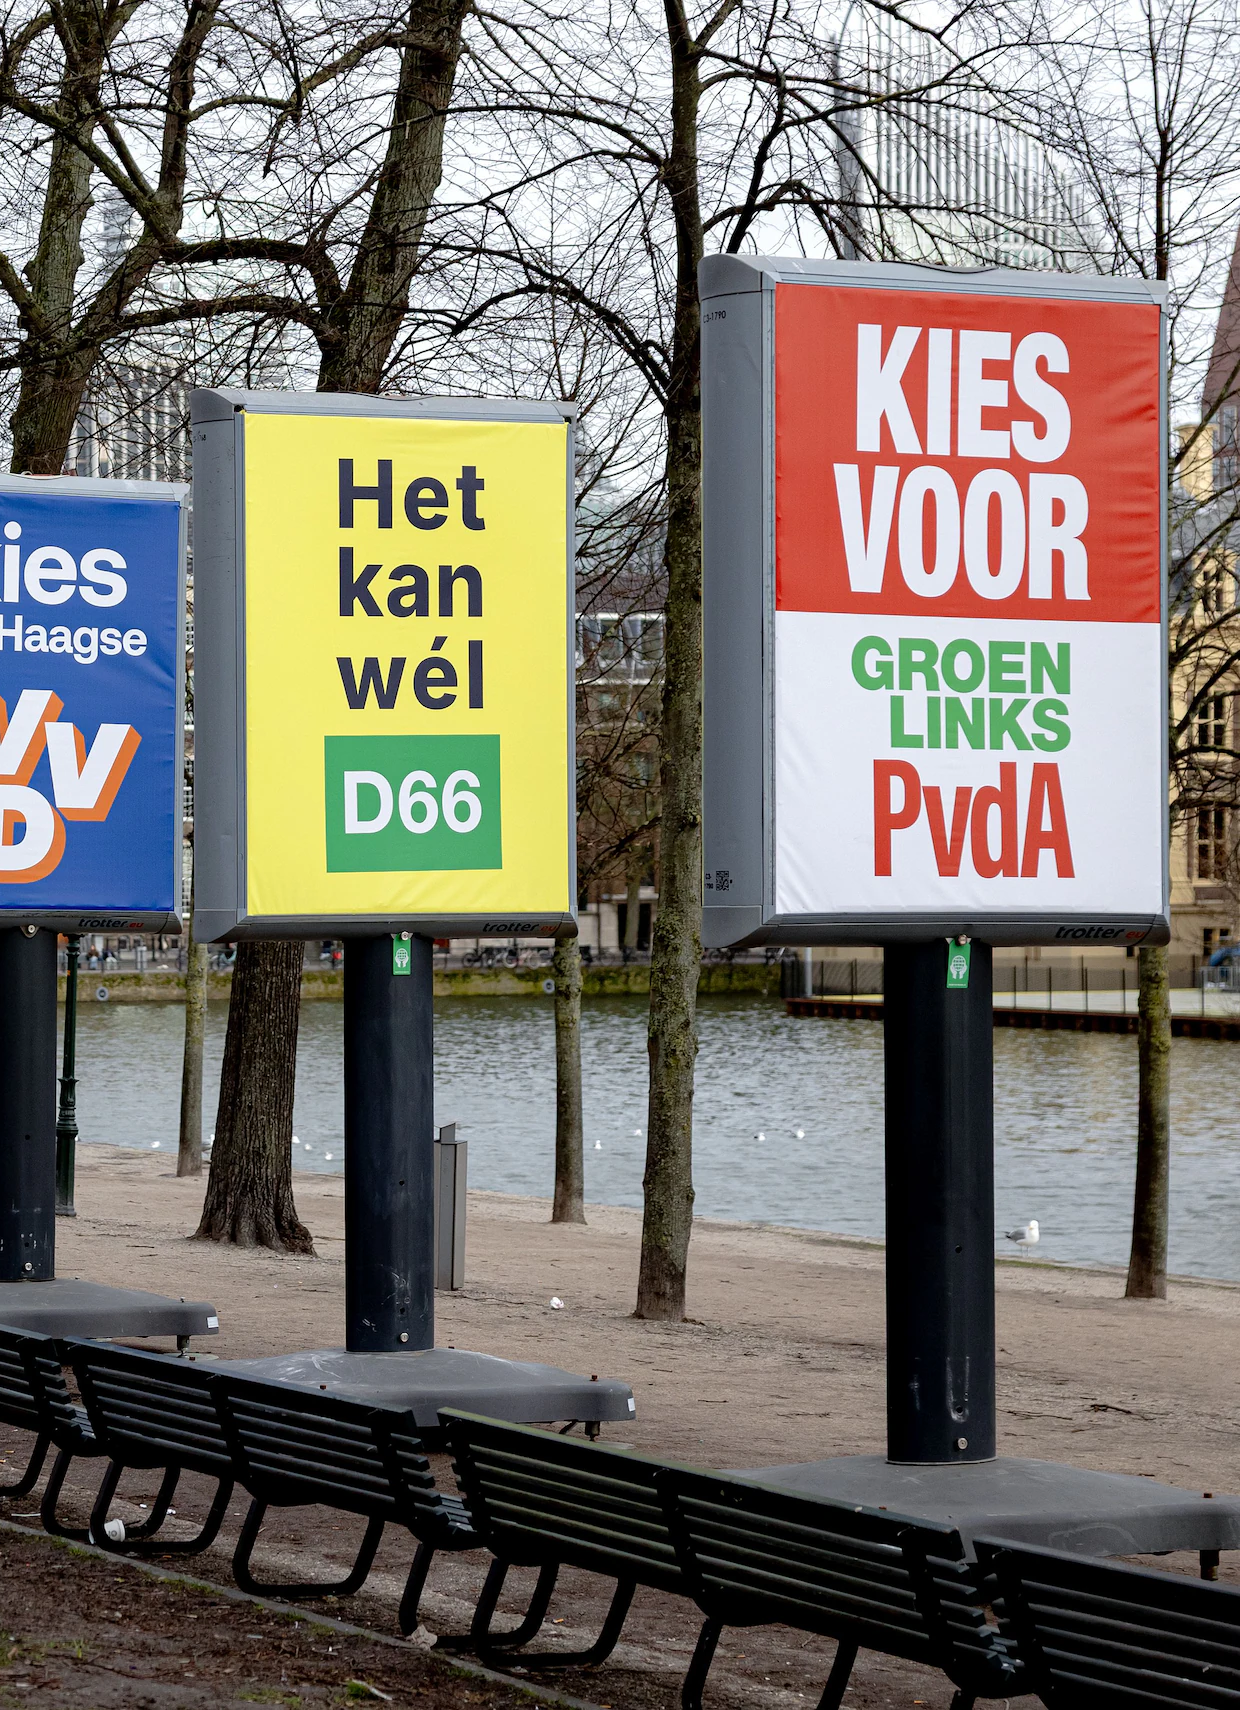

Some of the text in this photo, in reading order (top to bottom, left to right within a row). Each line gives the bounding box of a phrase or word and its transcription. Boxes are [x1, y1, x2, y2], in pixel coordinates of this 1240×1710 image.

[857, 323, 1071, 462] KIES
[337, 458, 486, 531] Het
[834, 463, 1091, 600] VOOR
[338, 547, 483, 618] kan
[336, 636, 483, 711] wél
[851, 635, 1070, 695] GROEN
[890, 695, 1071, 751] LINKS
[343, 770, 482, 836] D66
[874, 759, 1075, 879] PvdA
